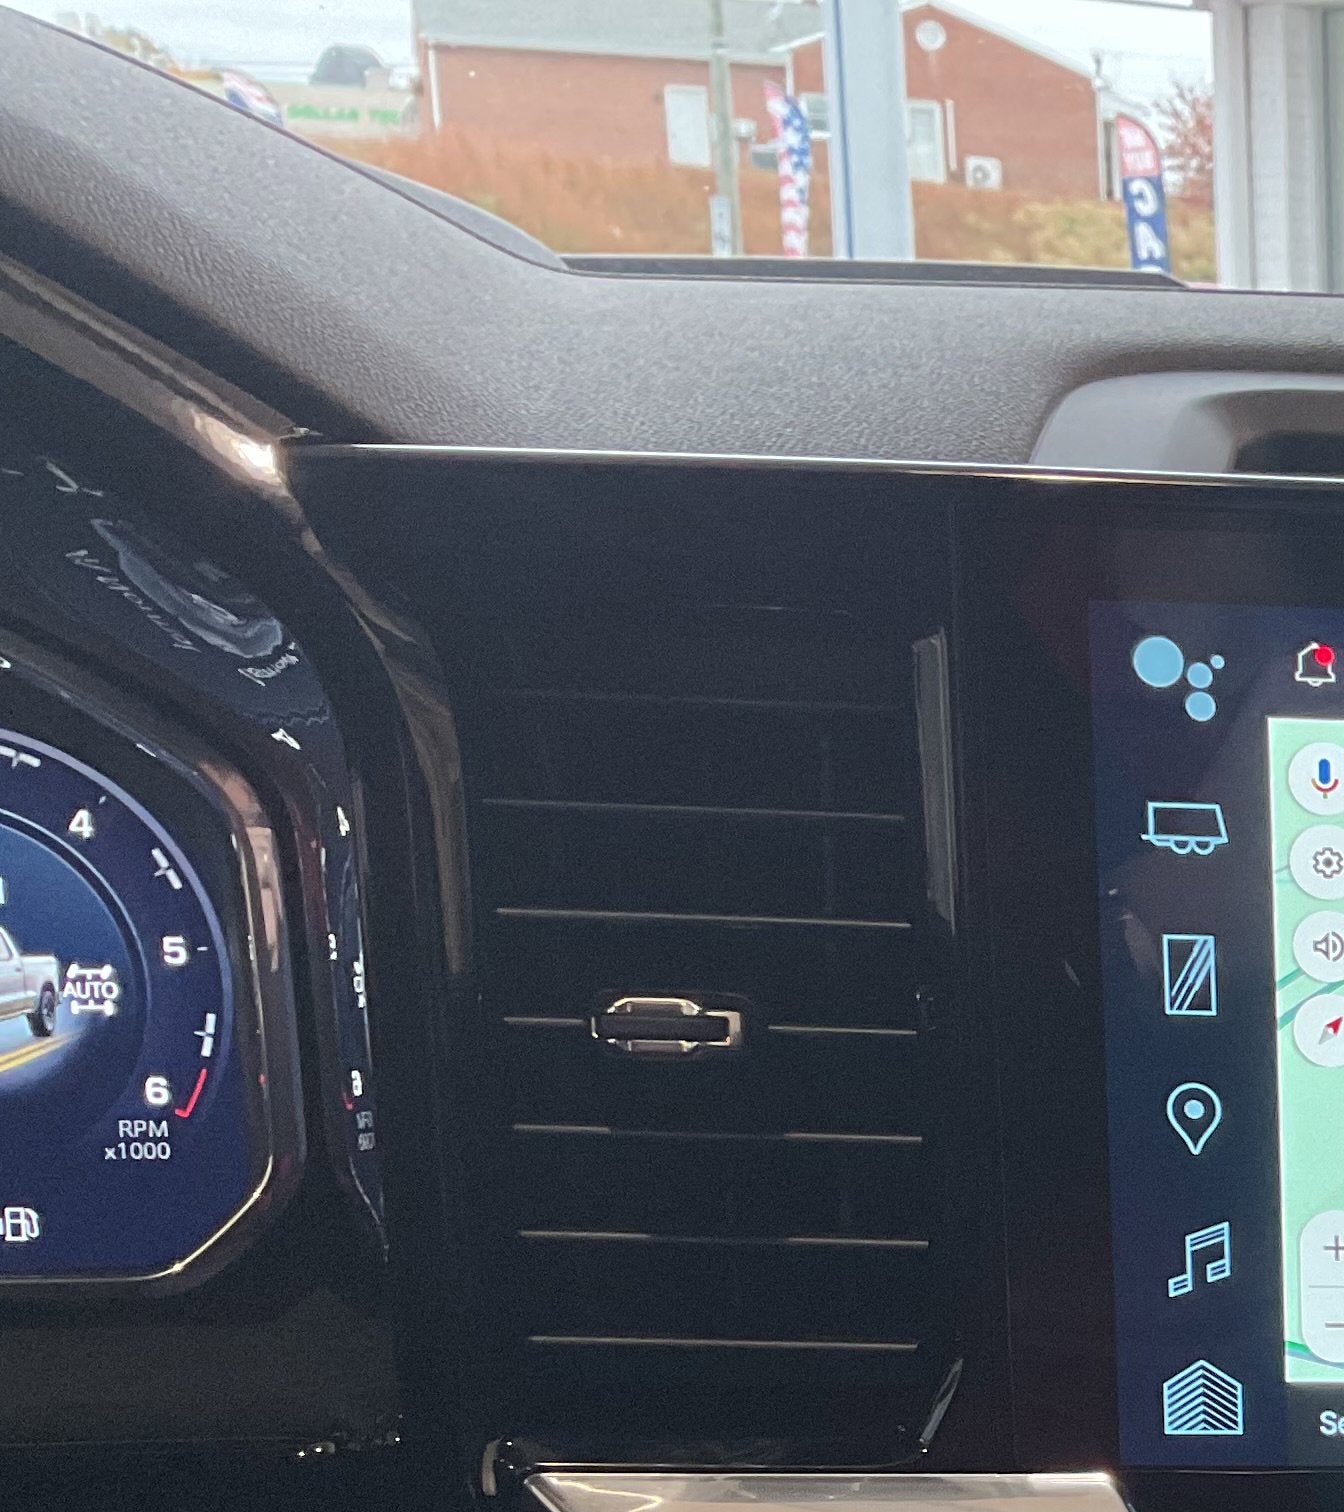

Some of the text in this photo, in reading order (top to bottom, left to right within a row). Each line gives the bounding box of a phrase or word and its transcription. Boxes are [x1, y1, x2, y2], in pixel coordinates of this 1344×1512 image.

[69, 809, 94, 838] 4
[161, 935, 188, 966] 5
[62, 980, 119, 1001] AUTO
[143, 1075, 170, 1106] 6
[118, 1120, 169, 1139] RPM
[103, 1141, 172, 1161] x1000
